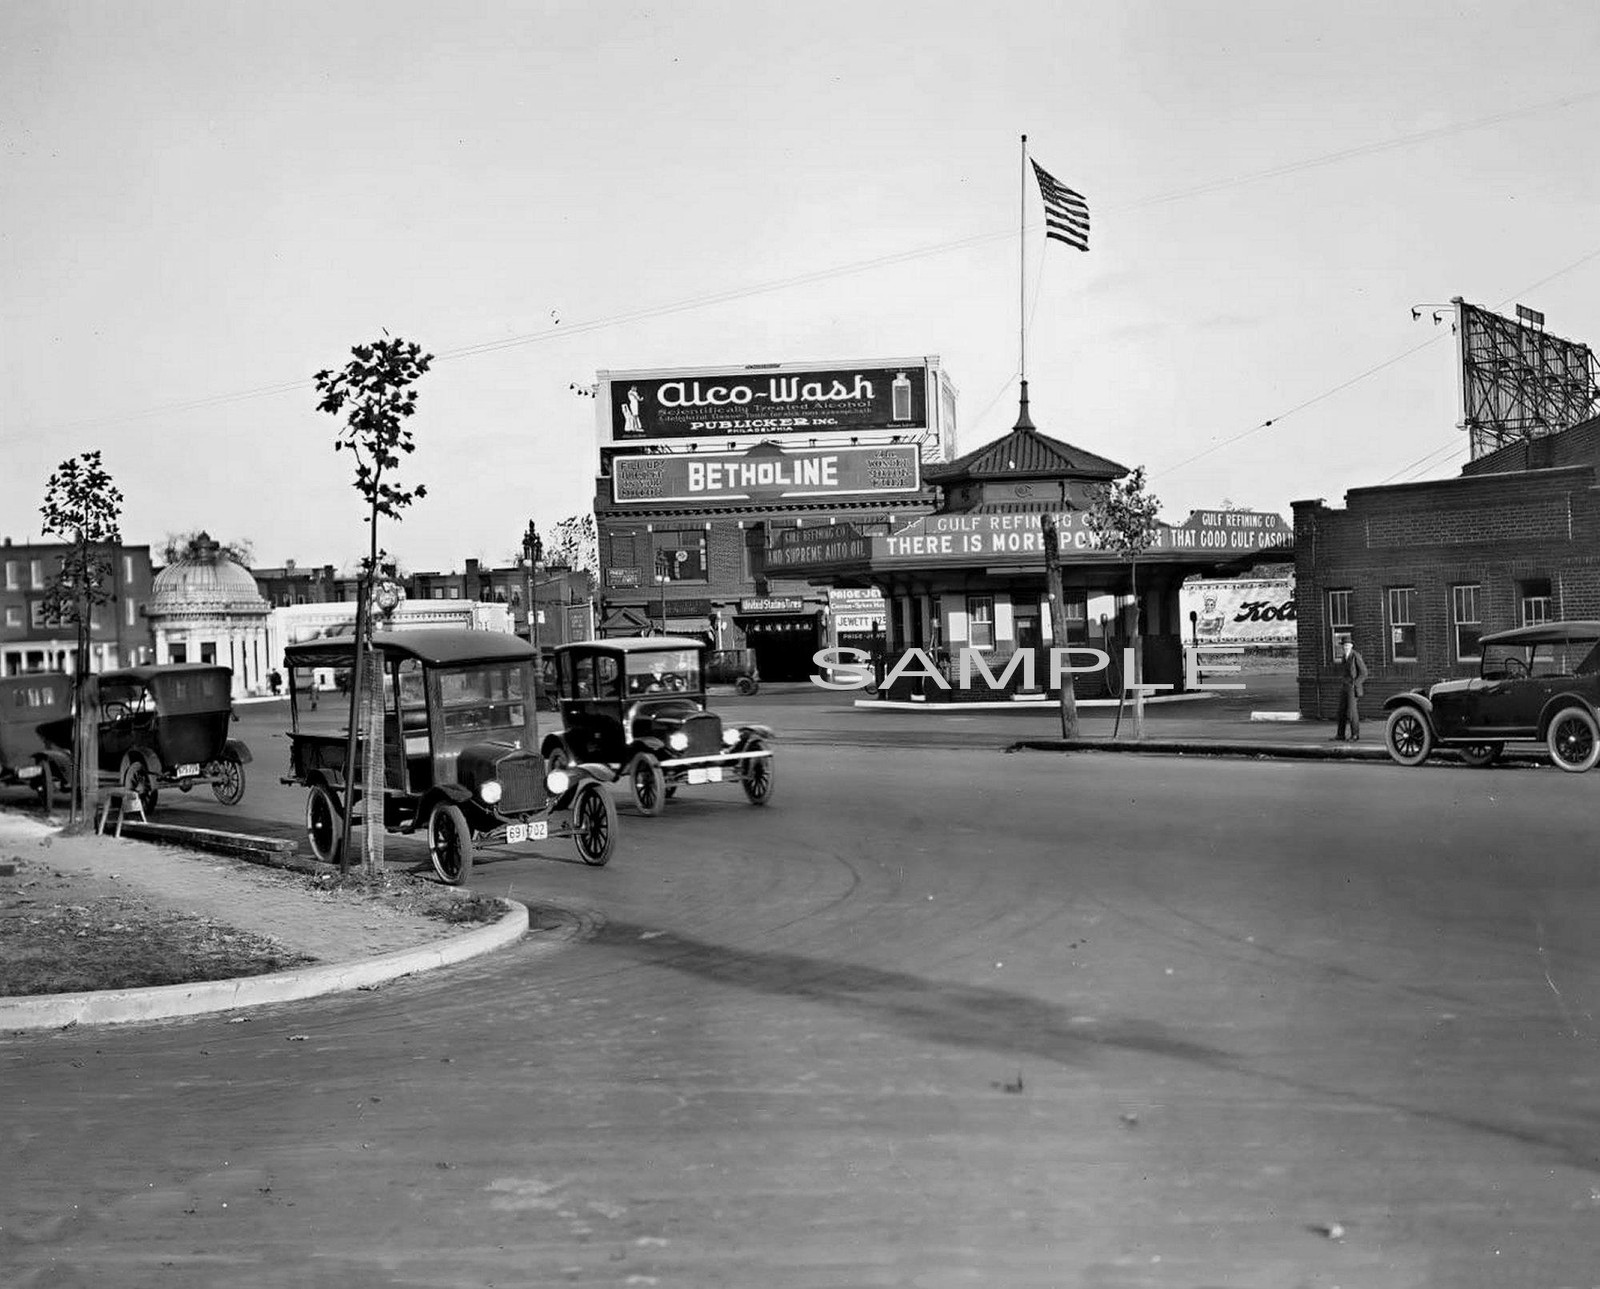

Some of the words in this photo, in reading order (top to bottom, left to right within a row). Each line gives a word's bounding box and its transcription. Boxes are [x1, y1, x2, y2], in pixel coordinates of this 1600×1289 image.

[813, 400, 872, 409] Alcohol
[690, 417, 809, 430] PUBLICKER
[812, 418, 838, 426] INC.
[727, 426, 793, 434] PHILADELPHIA
[688, 456, 838, 491] BETHOLINE
[938, 516, 980, 531] GULF
[990, 514, 1072, 529] REFINNG
[1202, 512, 1223, 526] GULF
[1226, 513, 1262, 528] REFINING
[1265, 515, 1276, 528] CO
[886, 535, 952, 555] THERE
[963, 534, 982, 552] IS
[992, 532, 1045, 552] MORE
[1171, 529, 1196, 547] THAT
[1200, 530, 1227, 547] GOOD
[1231, 531, 1255, 548] GULF
[785, 544, 822, 563] SUPREME
[825, 541, 848, 560] AUTO
[850, 539, 866, 557] OIL
[743, 599, 763, 610] United
[763, 598, 785, 610] States
[838, 616, 869, 626] JEWETT
